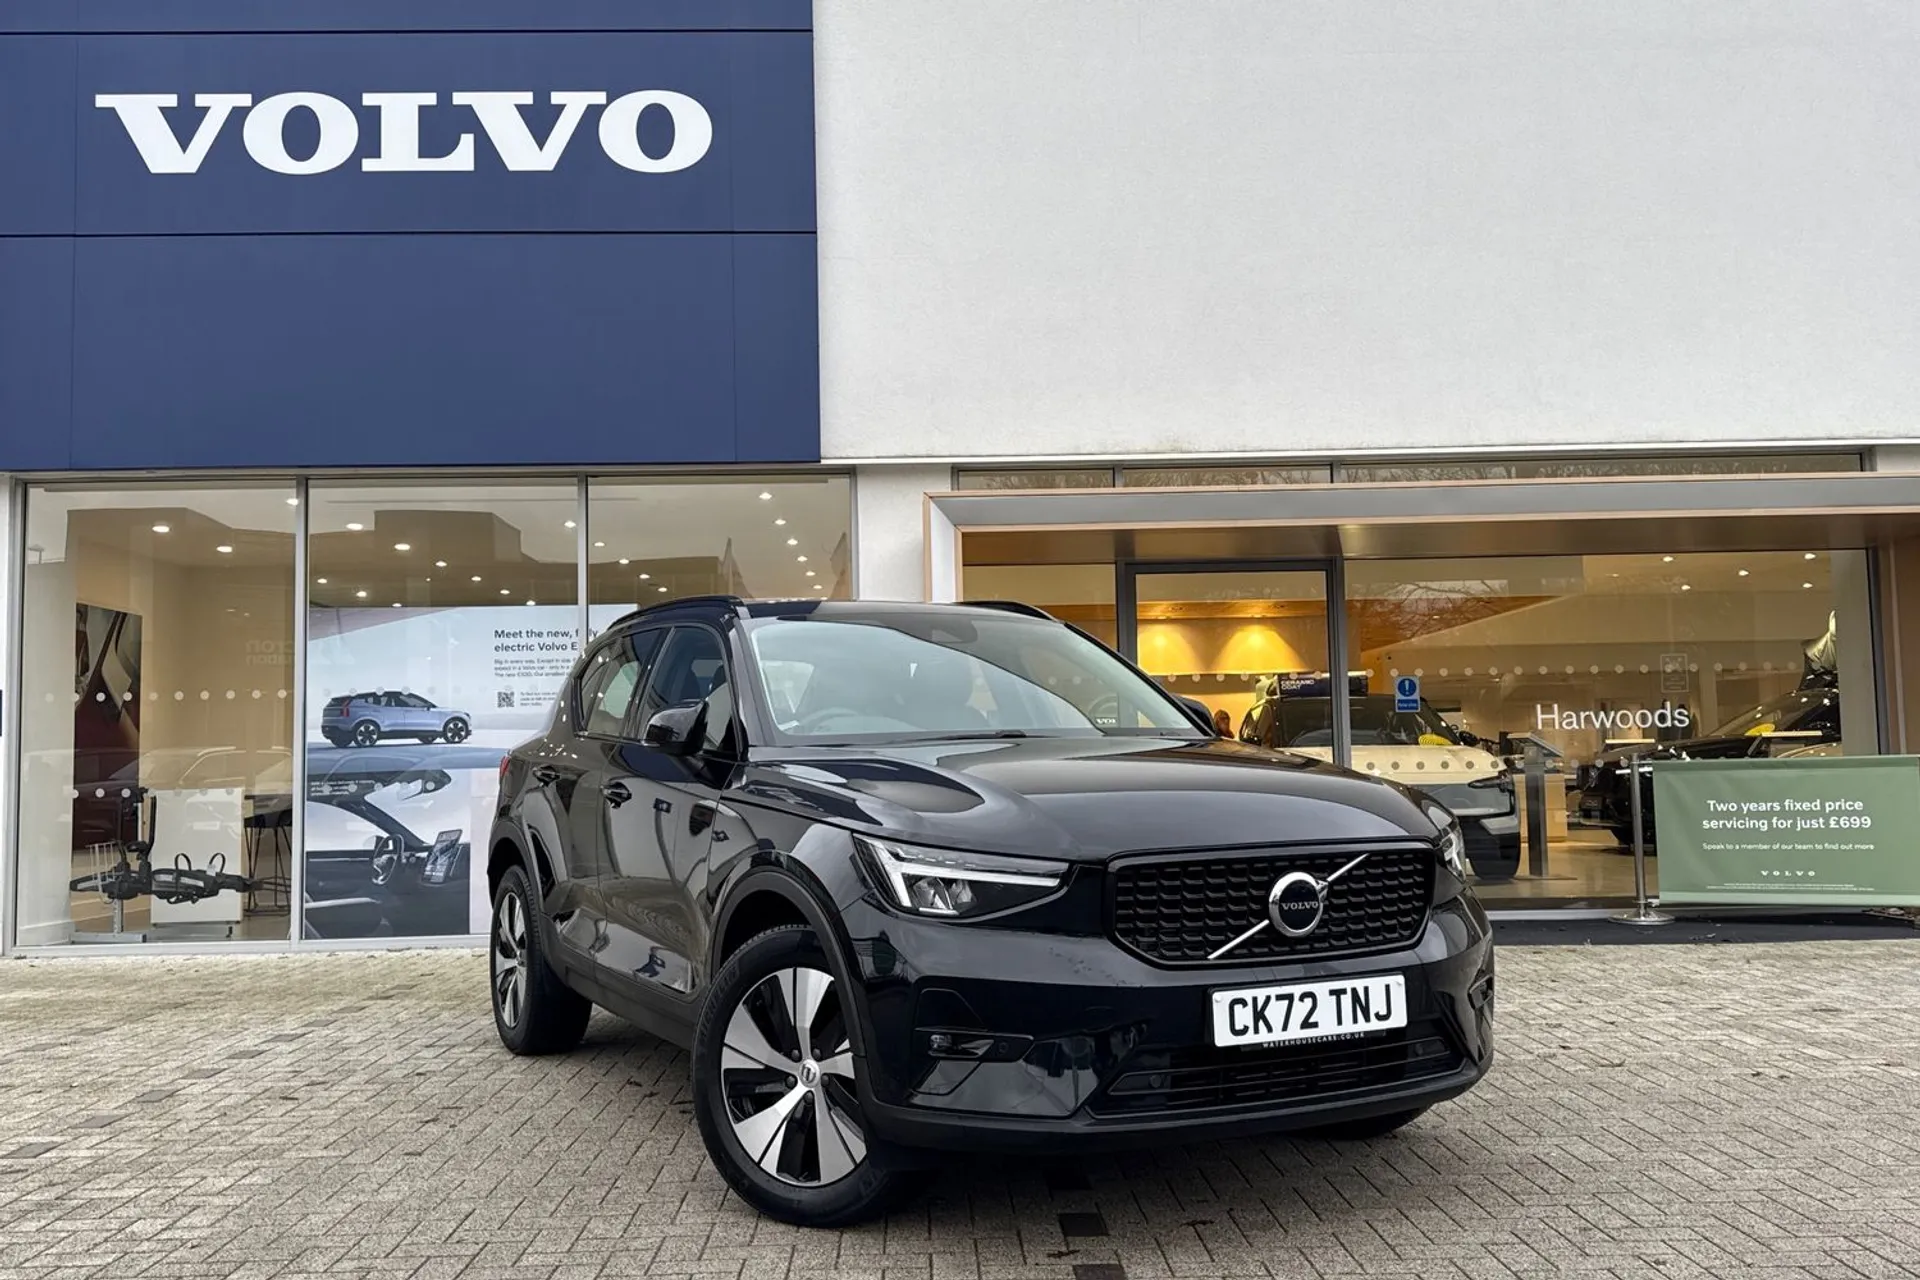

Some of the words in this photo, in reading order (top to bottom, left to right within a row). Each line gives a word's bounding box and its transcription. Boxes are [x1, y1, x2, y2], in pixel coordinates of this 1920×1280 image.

[95, 90, 713, 175] VOLVO
[494, 629, 523, 639] Meet
[526, 629, 544, 639] the
[547, 630, 573, 639] new,
[494, 642, 535, 652] electric
[537, 642, 568, 651] Volvo
[1536, 701, 1690, 730] Harwoods
[1707, 800, 1738, 812] Two
[1740, 802, 1781, 814] years
[1784, 798, 1821, 811] fixed
[1825, 798, 1864, 814] price
[1702, 816, 1768, 831] servicing
[1772, 816, 1793, 829] for
[1796, 816, 1825, 832] just
[1829, 816, 1872, 829] £699
[1281, 901, 1319, 910] VOLVO
[1228, 991, 1319, 1037] CK72
[1328, 983, 1393, 1027] TNJ
